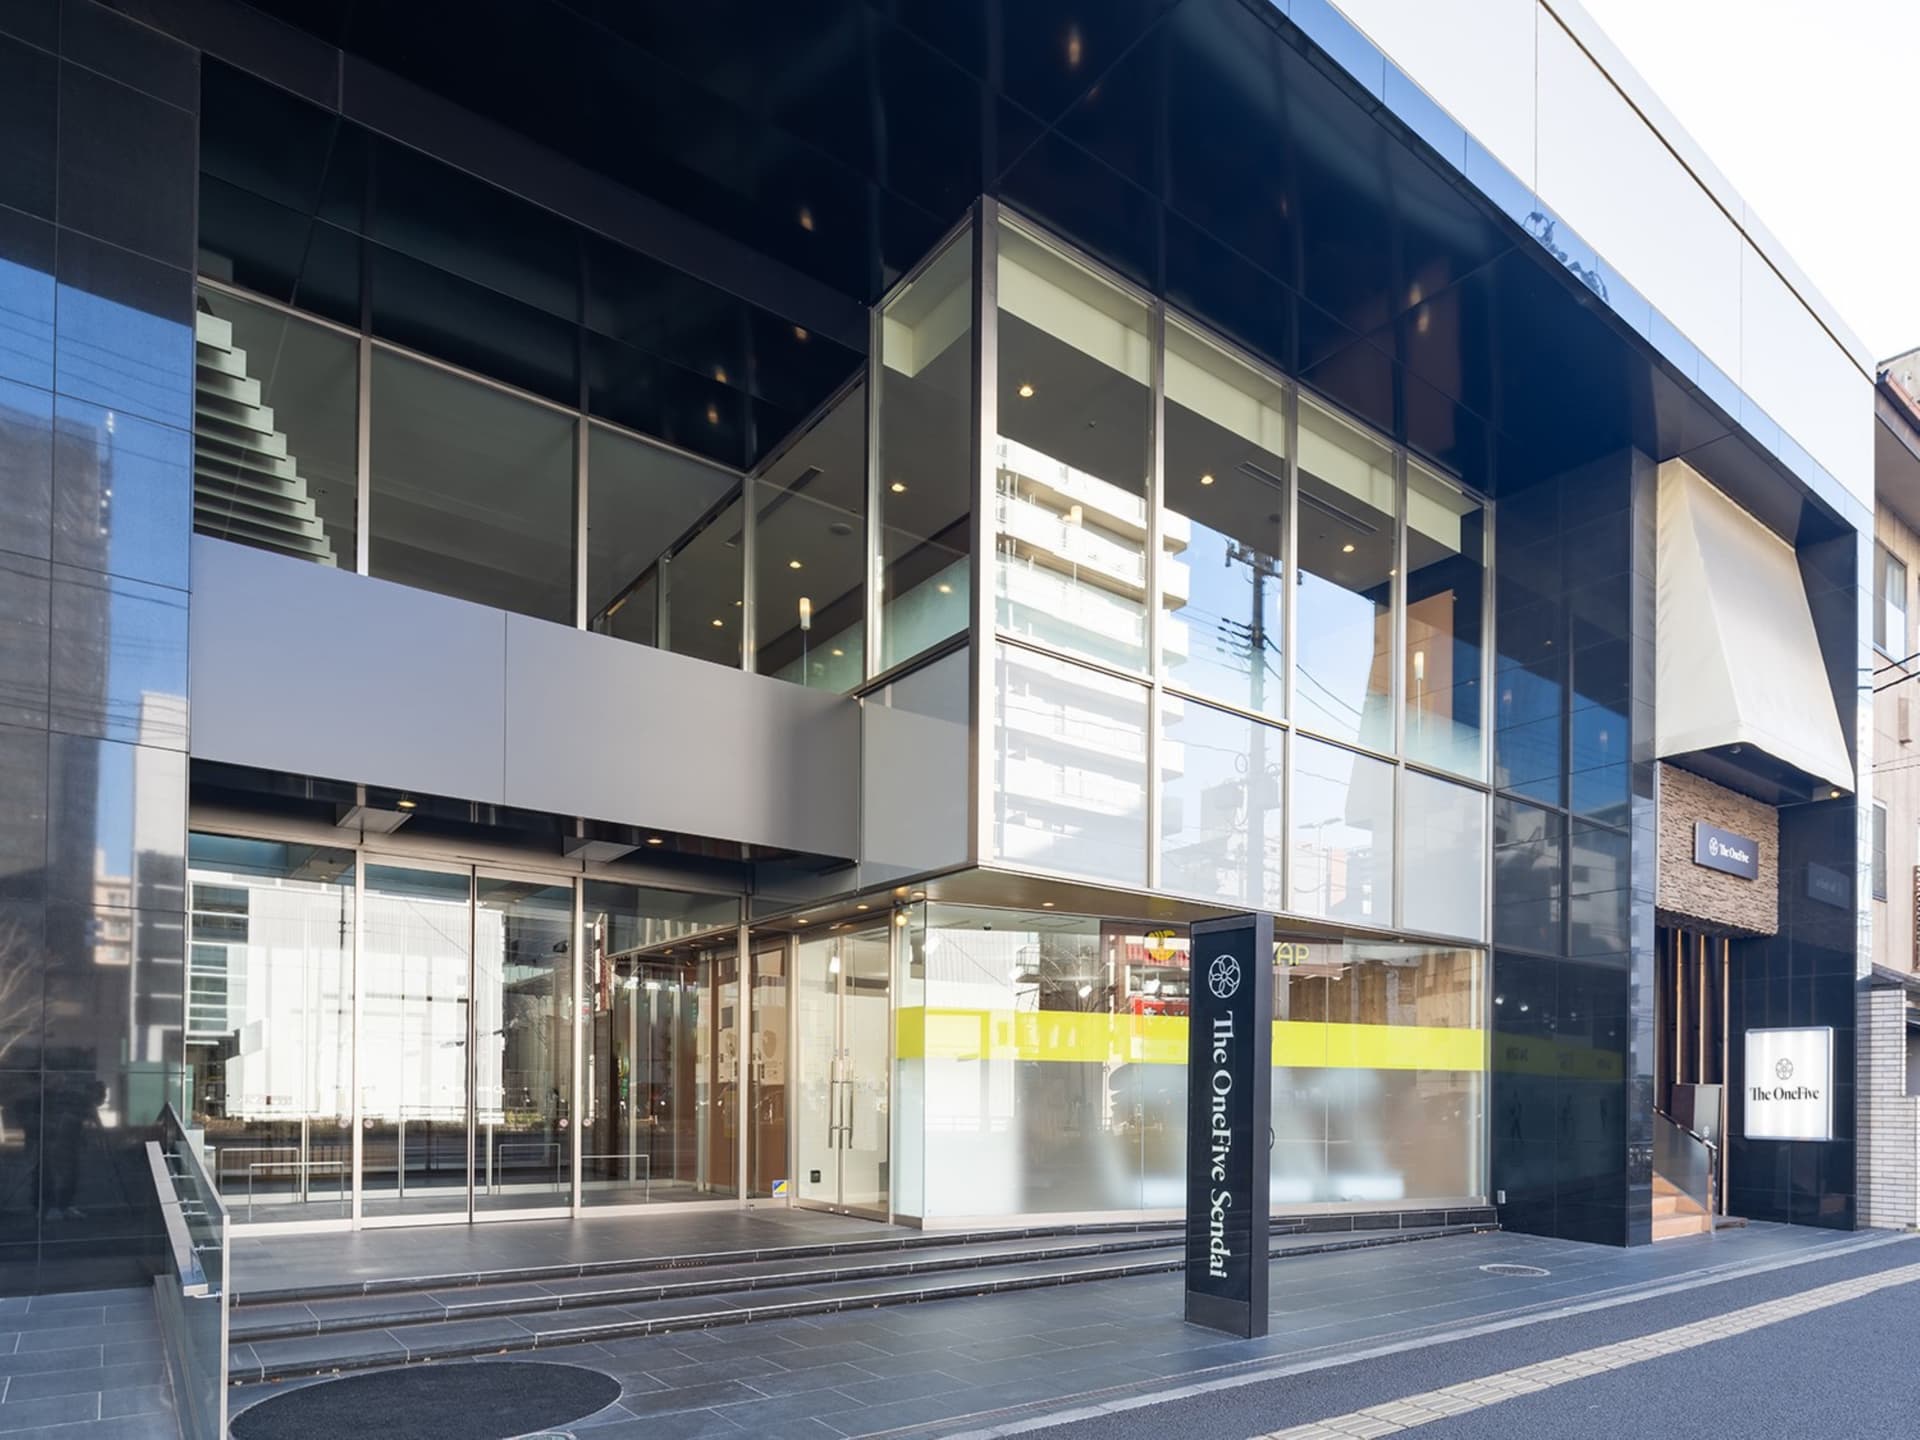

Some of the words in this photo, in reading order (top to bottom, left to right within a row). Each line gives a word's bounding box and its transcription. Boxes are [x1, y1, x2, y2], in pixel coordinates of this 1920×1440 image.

[1272, 942, 1310, 966] AP
[1213, 1009, 1234, 1063] The
[1749, 1087, 1771, 1101] The
[1773, 1087, 1819, 1101] OneFive
[1211, 1069, 1232, 1181] OneFive
[1209, 1188, 1232, 1278] Sendai
